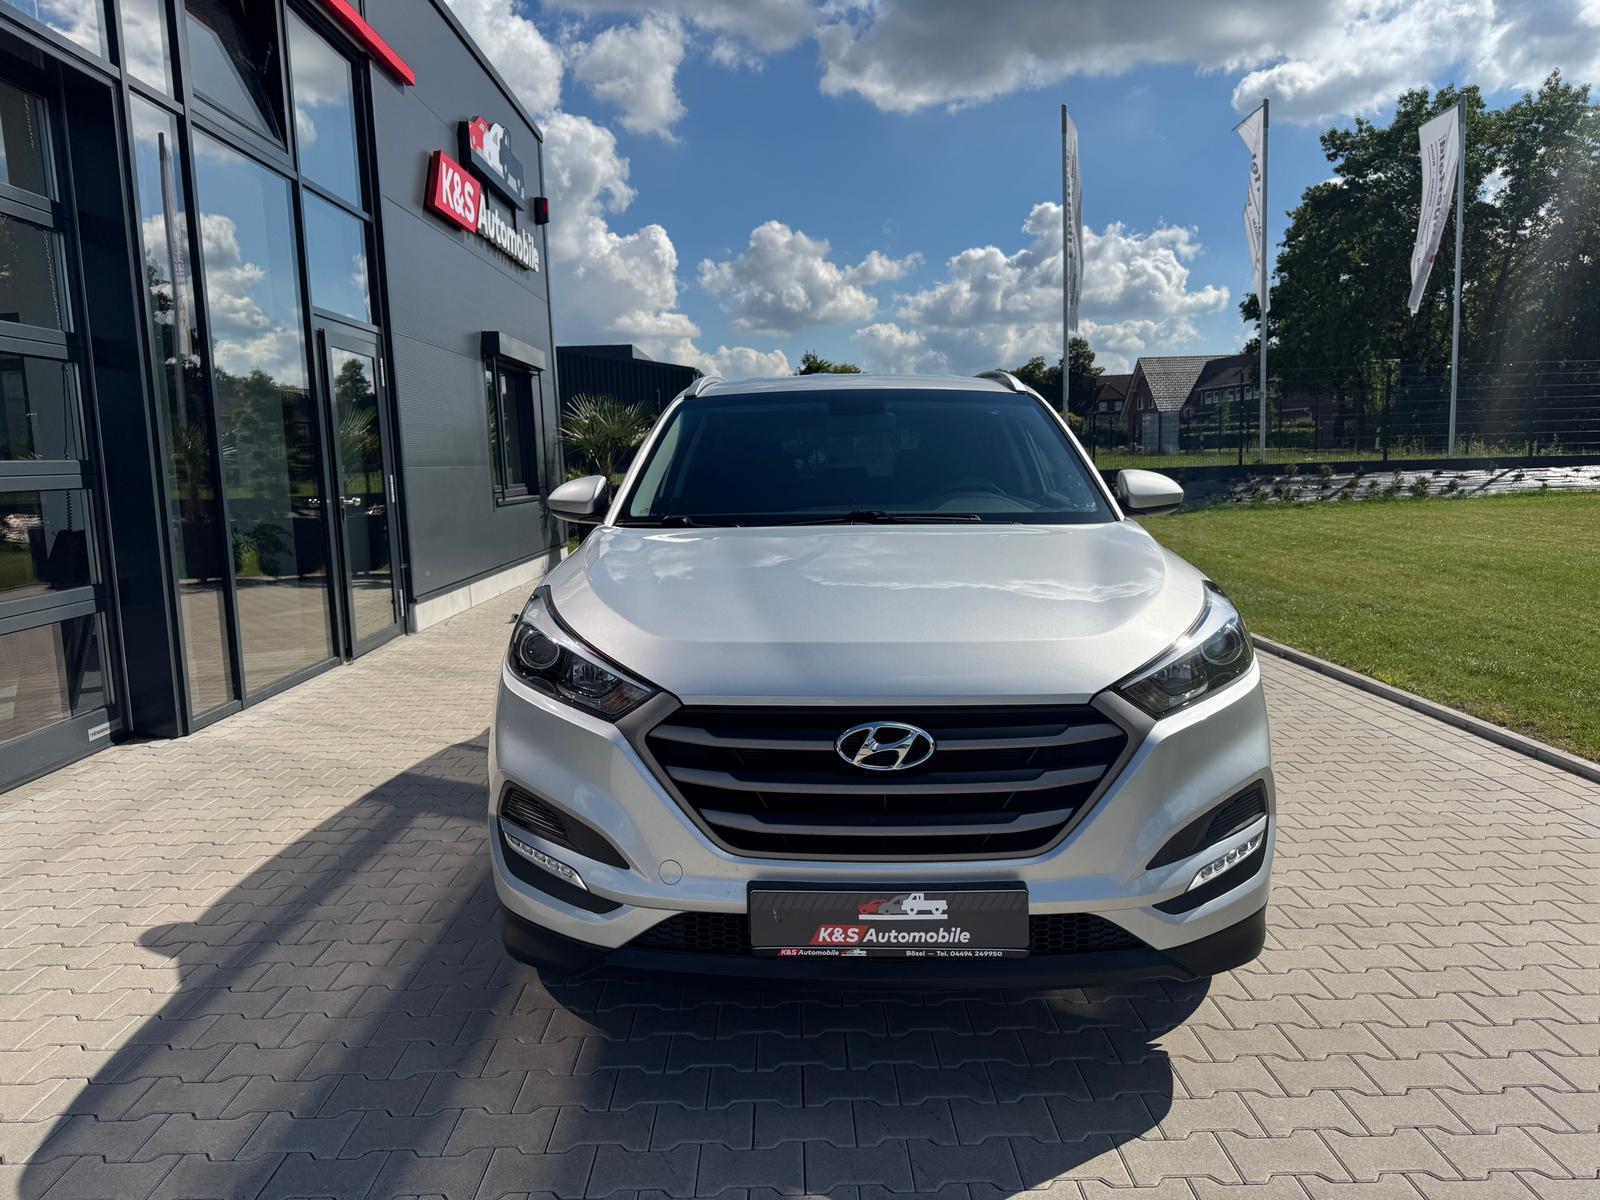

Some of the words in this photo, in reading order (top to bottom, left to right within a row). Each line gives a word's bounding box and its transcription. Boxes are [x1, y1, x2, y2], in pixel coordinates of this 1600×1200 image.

[441, 161, 475, 224] K&S
[477, 193, 540, 273] Automobile
[818, 927, 860, 943] K&S
[863, 927, 970, 943] Automobile
